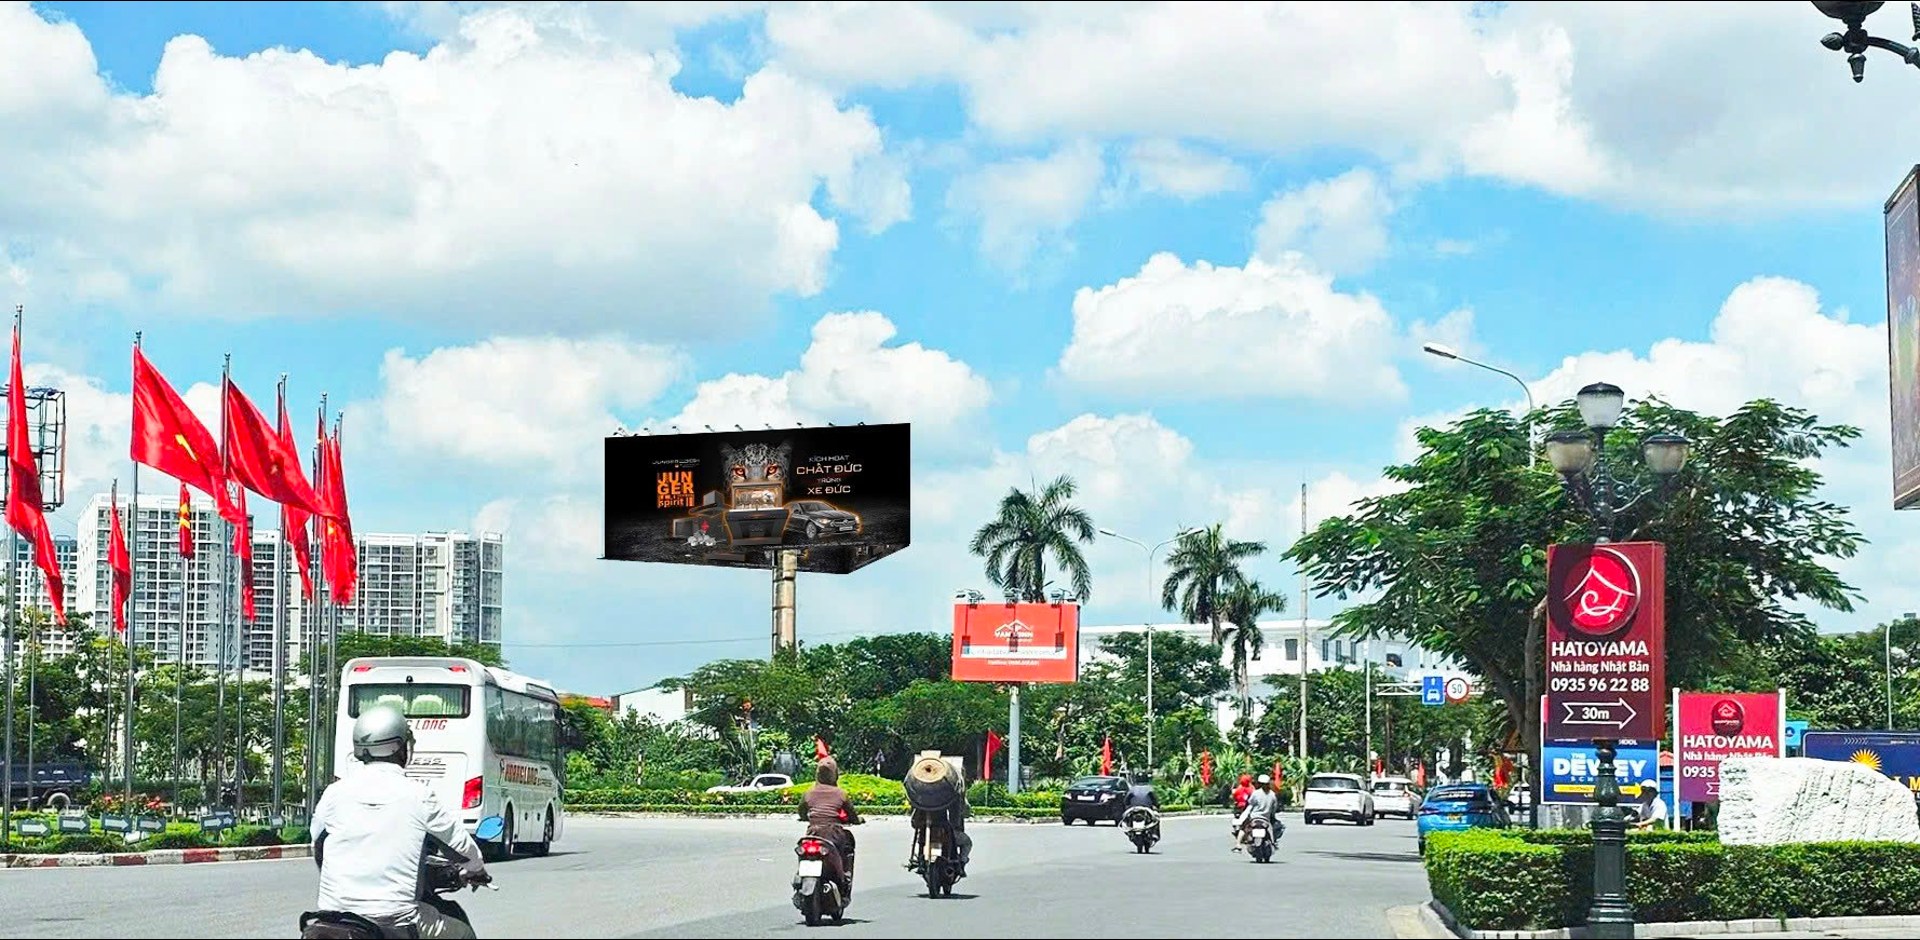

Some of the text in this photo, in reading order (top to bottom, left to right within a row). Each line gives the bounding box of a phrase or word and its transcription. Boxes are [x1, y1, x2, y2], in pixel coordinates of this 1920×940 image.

[834, 461, 863, 473] ĐỨC
[657, 482, 694, 495] GER
[807, 483, 851, 495] XE ĐỨC
[1551, 641, 1649, 656] HATOYAMA
[1551, 661, 1649, 674] Nhà hàng Nhật Bản
[1451, 683, 1463, 694] 50
[1551, 678, 1650, 692] 0935 96 22 88
[1582, 707, 1610, 719] 30m
[1683, 735, 1774, 748] HATOYAMA
[1683, 751, 1703, 761] Nhà
[1683, 766, 1716, 778] 0935
